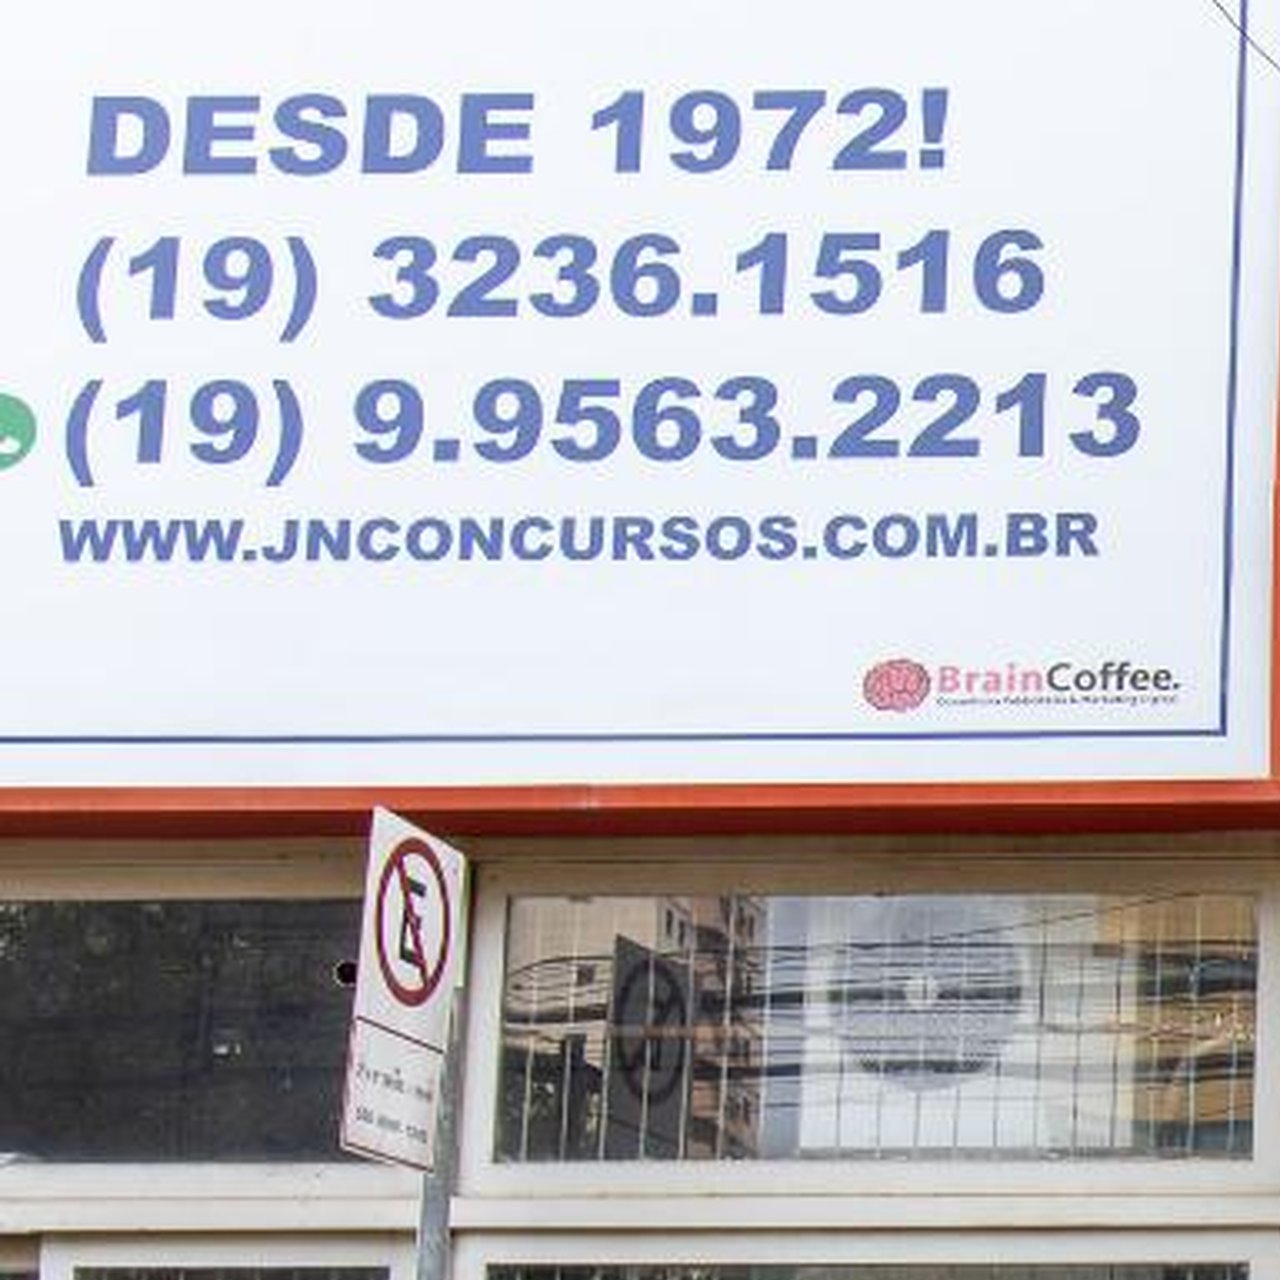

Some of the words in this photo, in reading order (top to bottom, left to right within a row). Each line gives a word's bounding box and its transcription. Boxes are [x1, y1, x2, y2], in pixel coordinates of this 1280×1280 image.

[86, 92, 536, 177] DESDE
[591, 87, 950, 175] 1972!
[76, 235, 318, 344] (19)
[368, 229, 1045, 321] 3236.1516
[65, 378, 304, 488] (19)
[353, 371, 1142, 466] 9.9563.2213
[58, 512, 1100, 564] WWW.JNCONCURSOS.COM.BR
